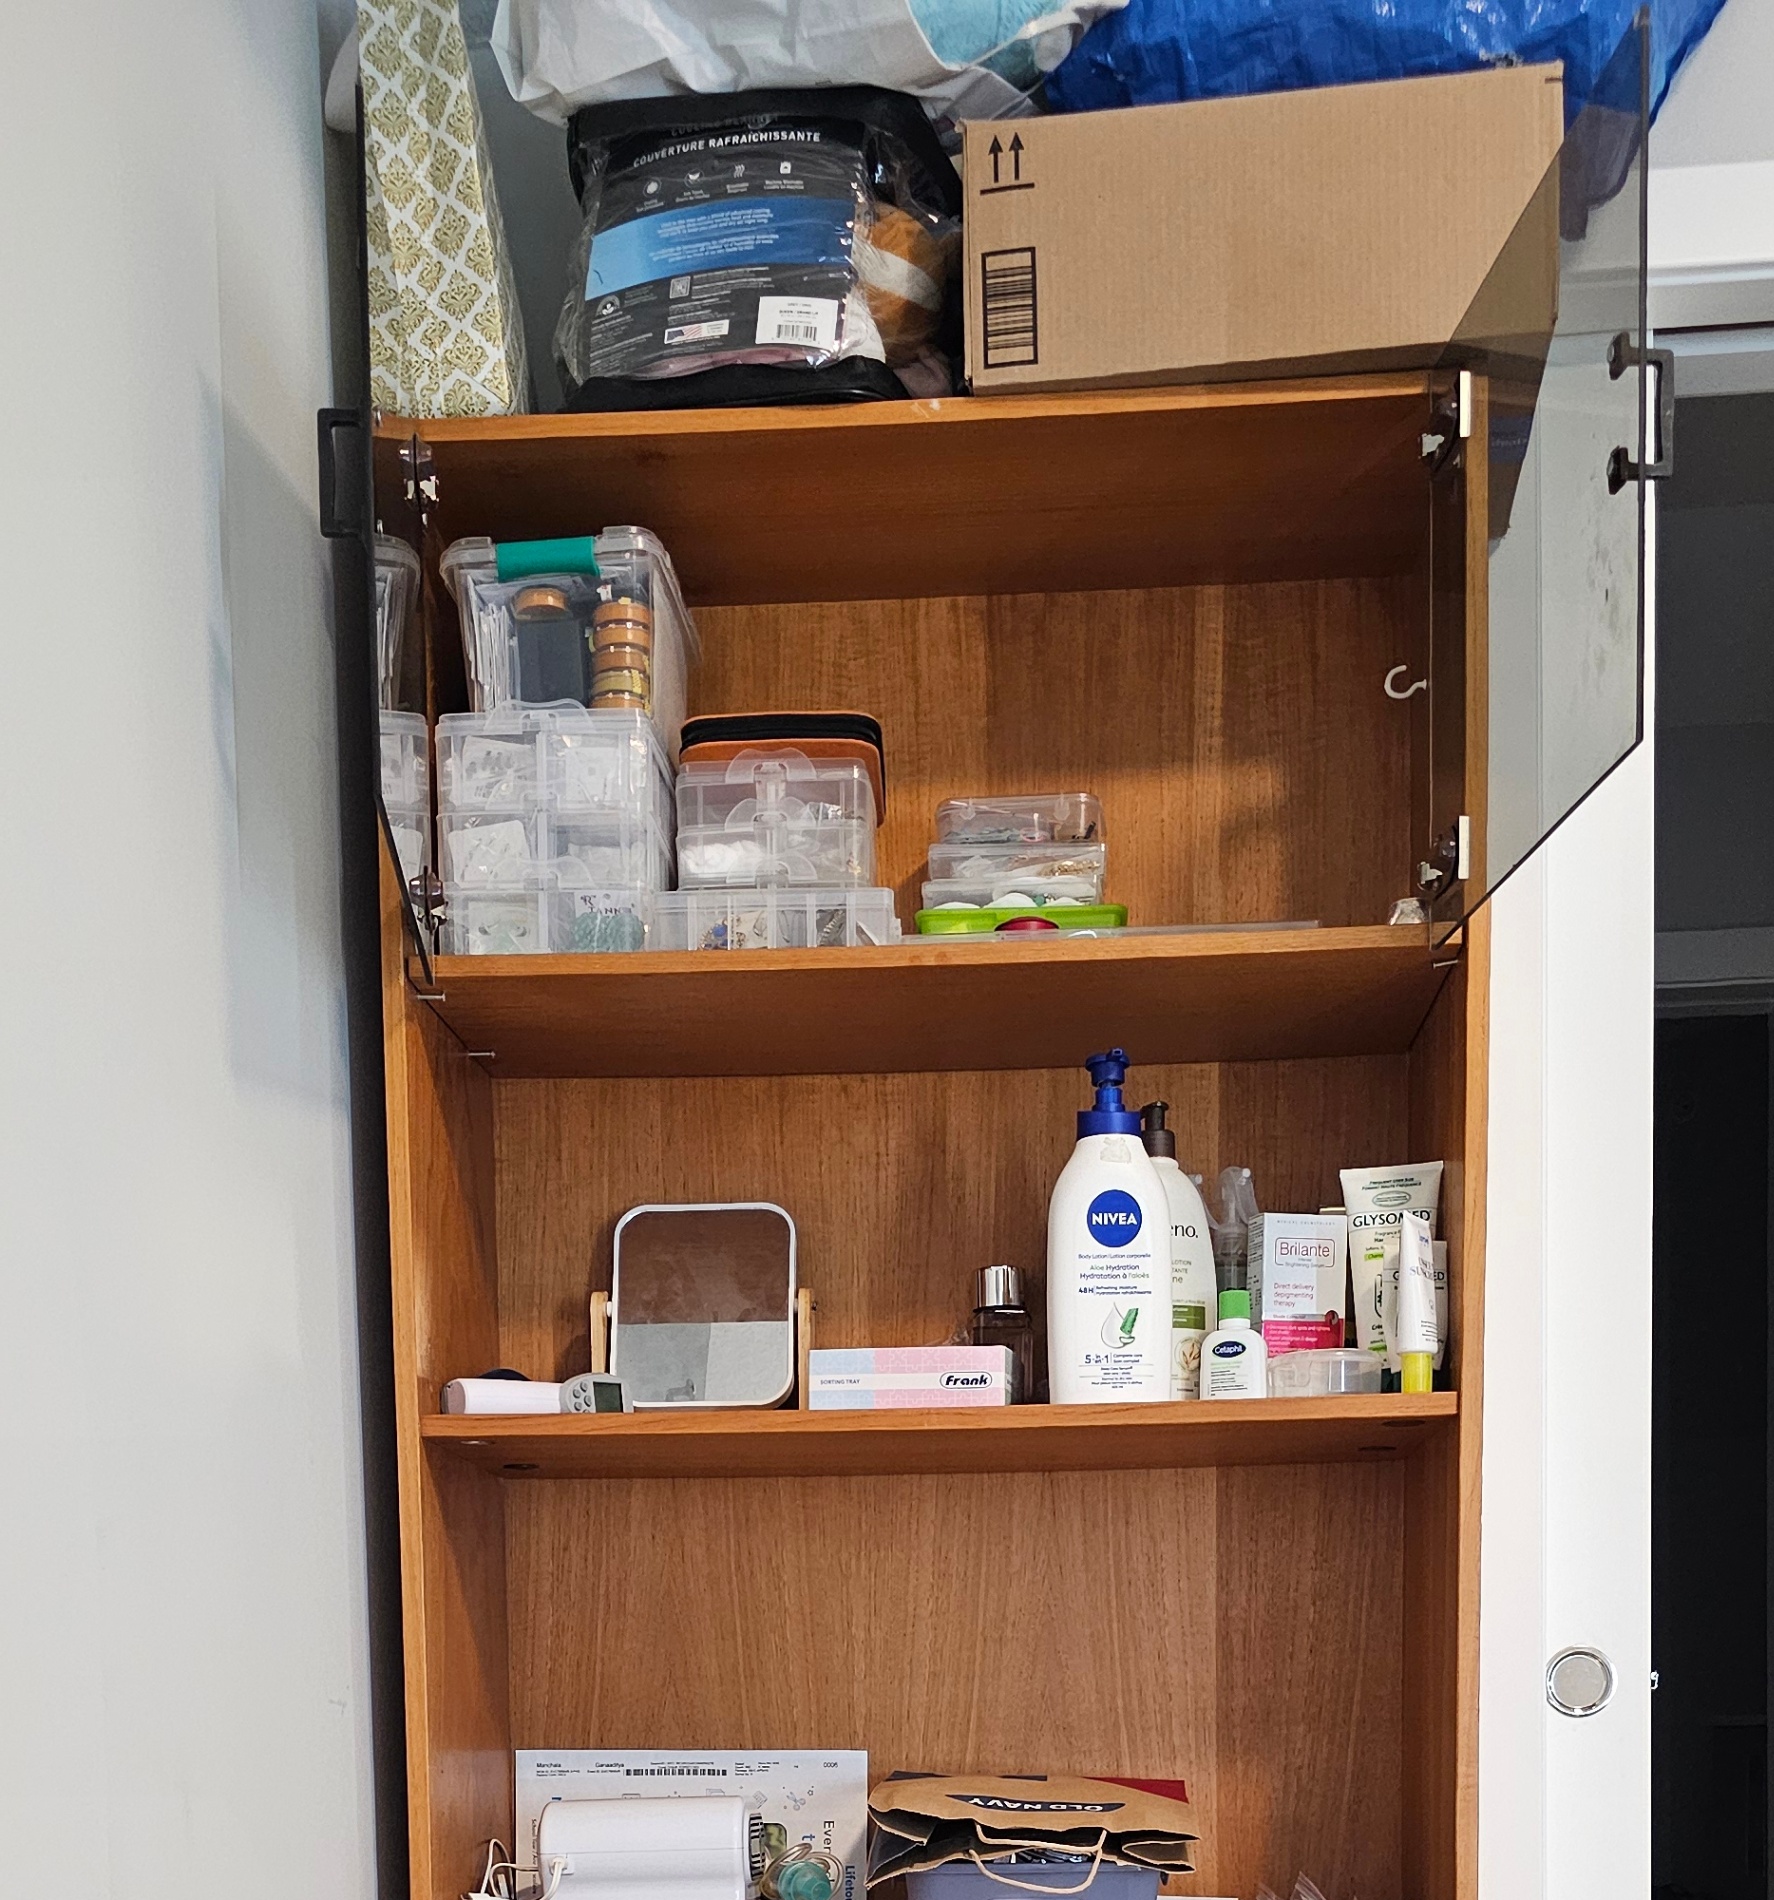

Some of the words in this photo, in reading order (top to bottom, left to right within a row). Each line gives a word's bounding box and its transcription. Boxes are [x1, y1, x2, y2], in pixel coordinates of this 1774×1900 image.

[633, 140, 705, 168] COUVERTURE
[1091, 1212, 1137, 1225] NIVEA
[1280, 1242, 1331, 1258] Brilante
[1105, 1264, 1140, 1272] Hydration
[1079, 1273, 1120, 1281] Hydratation
[1291, 1283, 1315, 1292] delivery
[1273, 1300, 1296, 1308] therapy
[1214, 1344, 1243, 1354] Cetaphil
[945, 1374, 988, 1387] Frank
[968, 1797, 1042, 1811] NAVY
[1049, 1803, 1104, 1812] OLD
